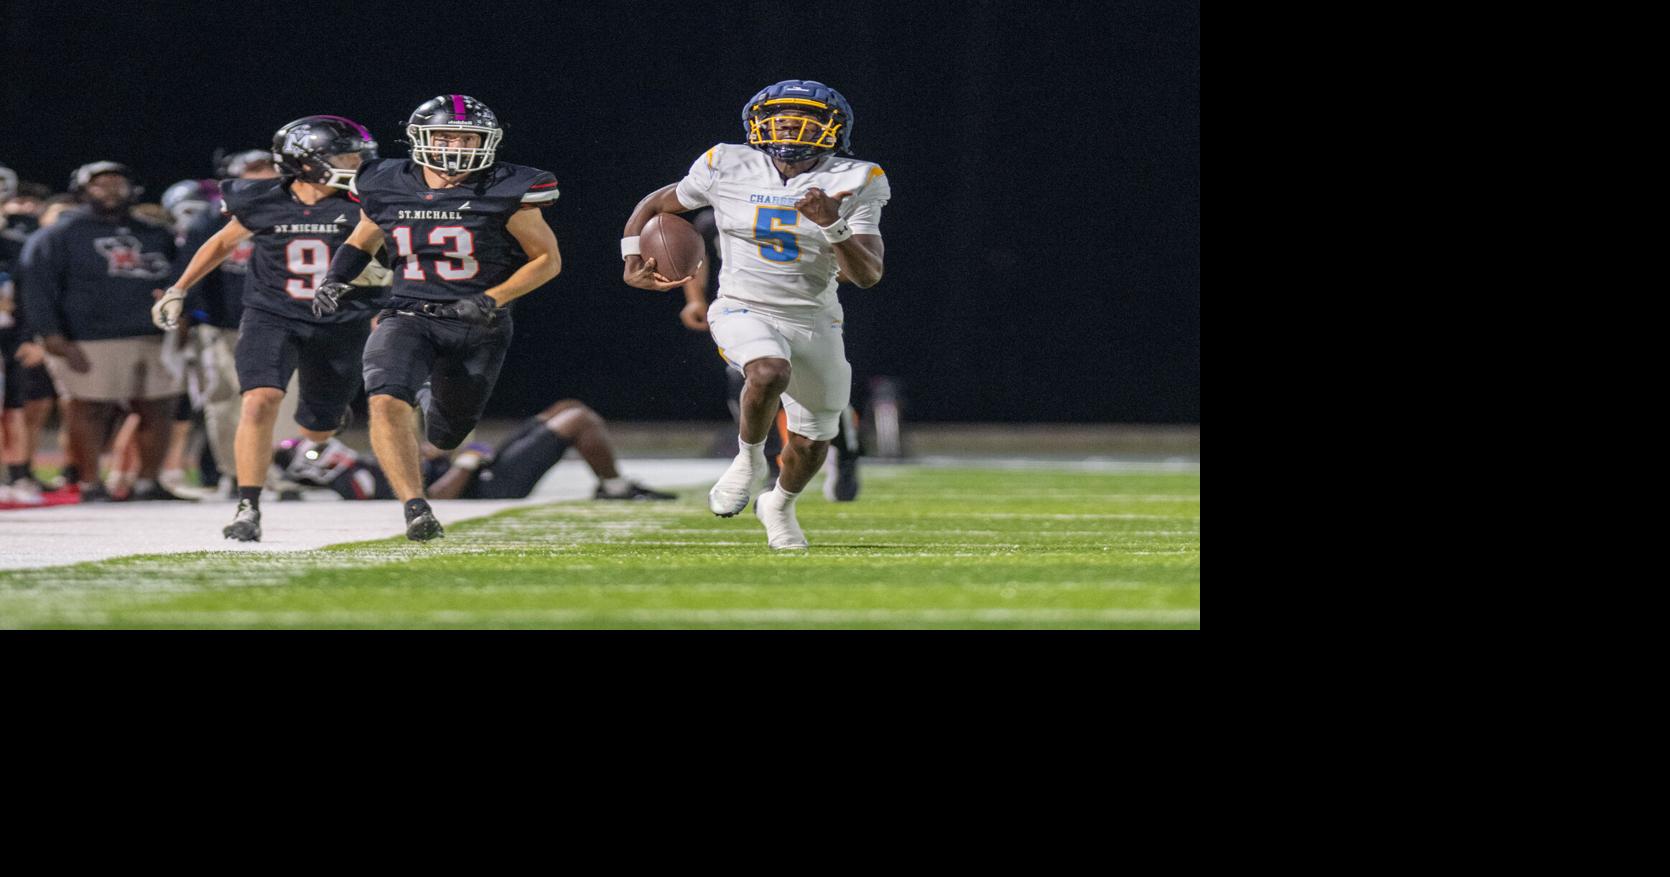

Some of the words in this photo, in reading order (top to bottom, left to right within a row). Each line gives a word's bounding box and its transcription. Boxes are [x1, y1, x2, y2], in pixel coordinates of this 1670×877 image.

[391, 225, 480, 281] 13
[753, 205, 803, 264] 5
[285, 237, 331, 301] 9
